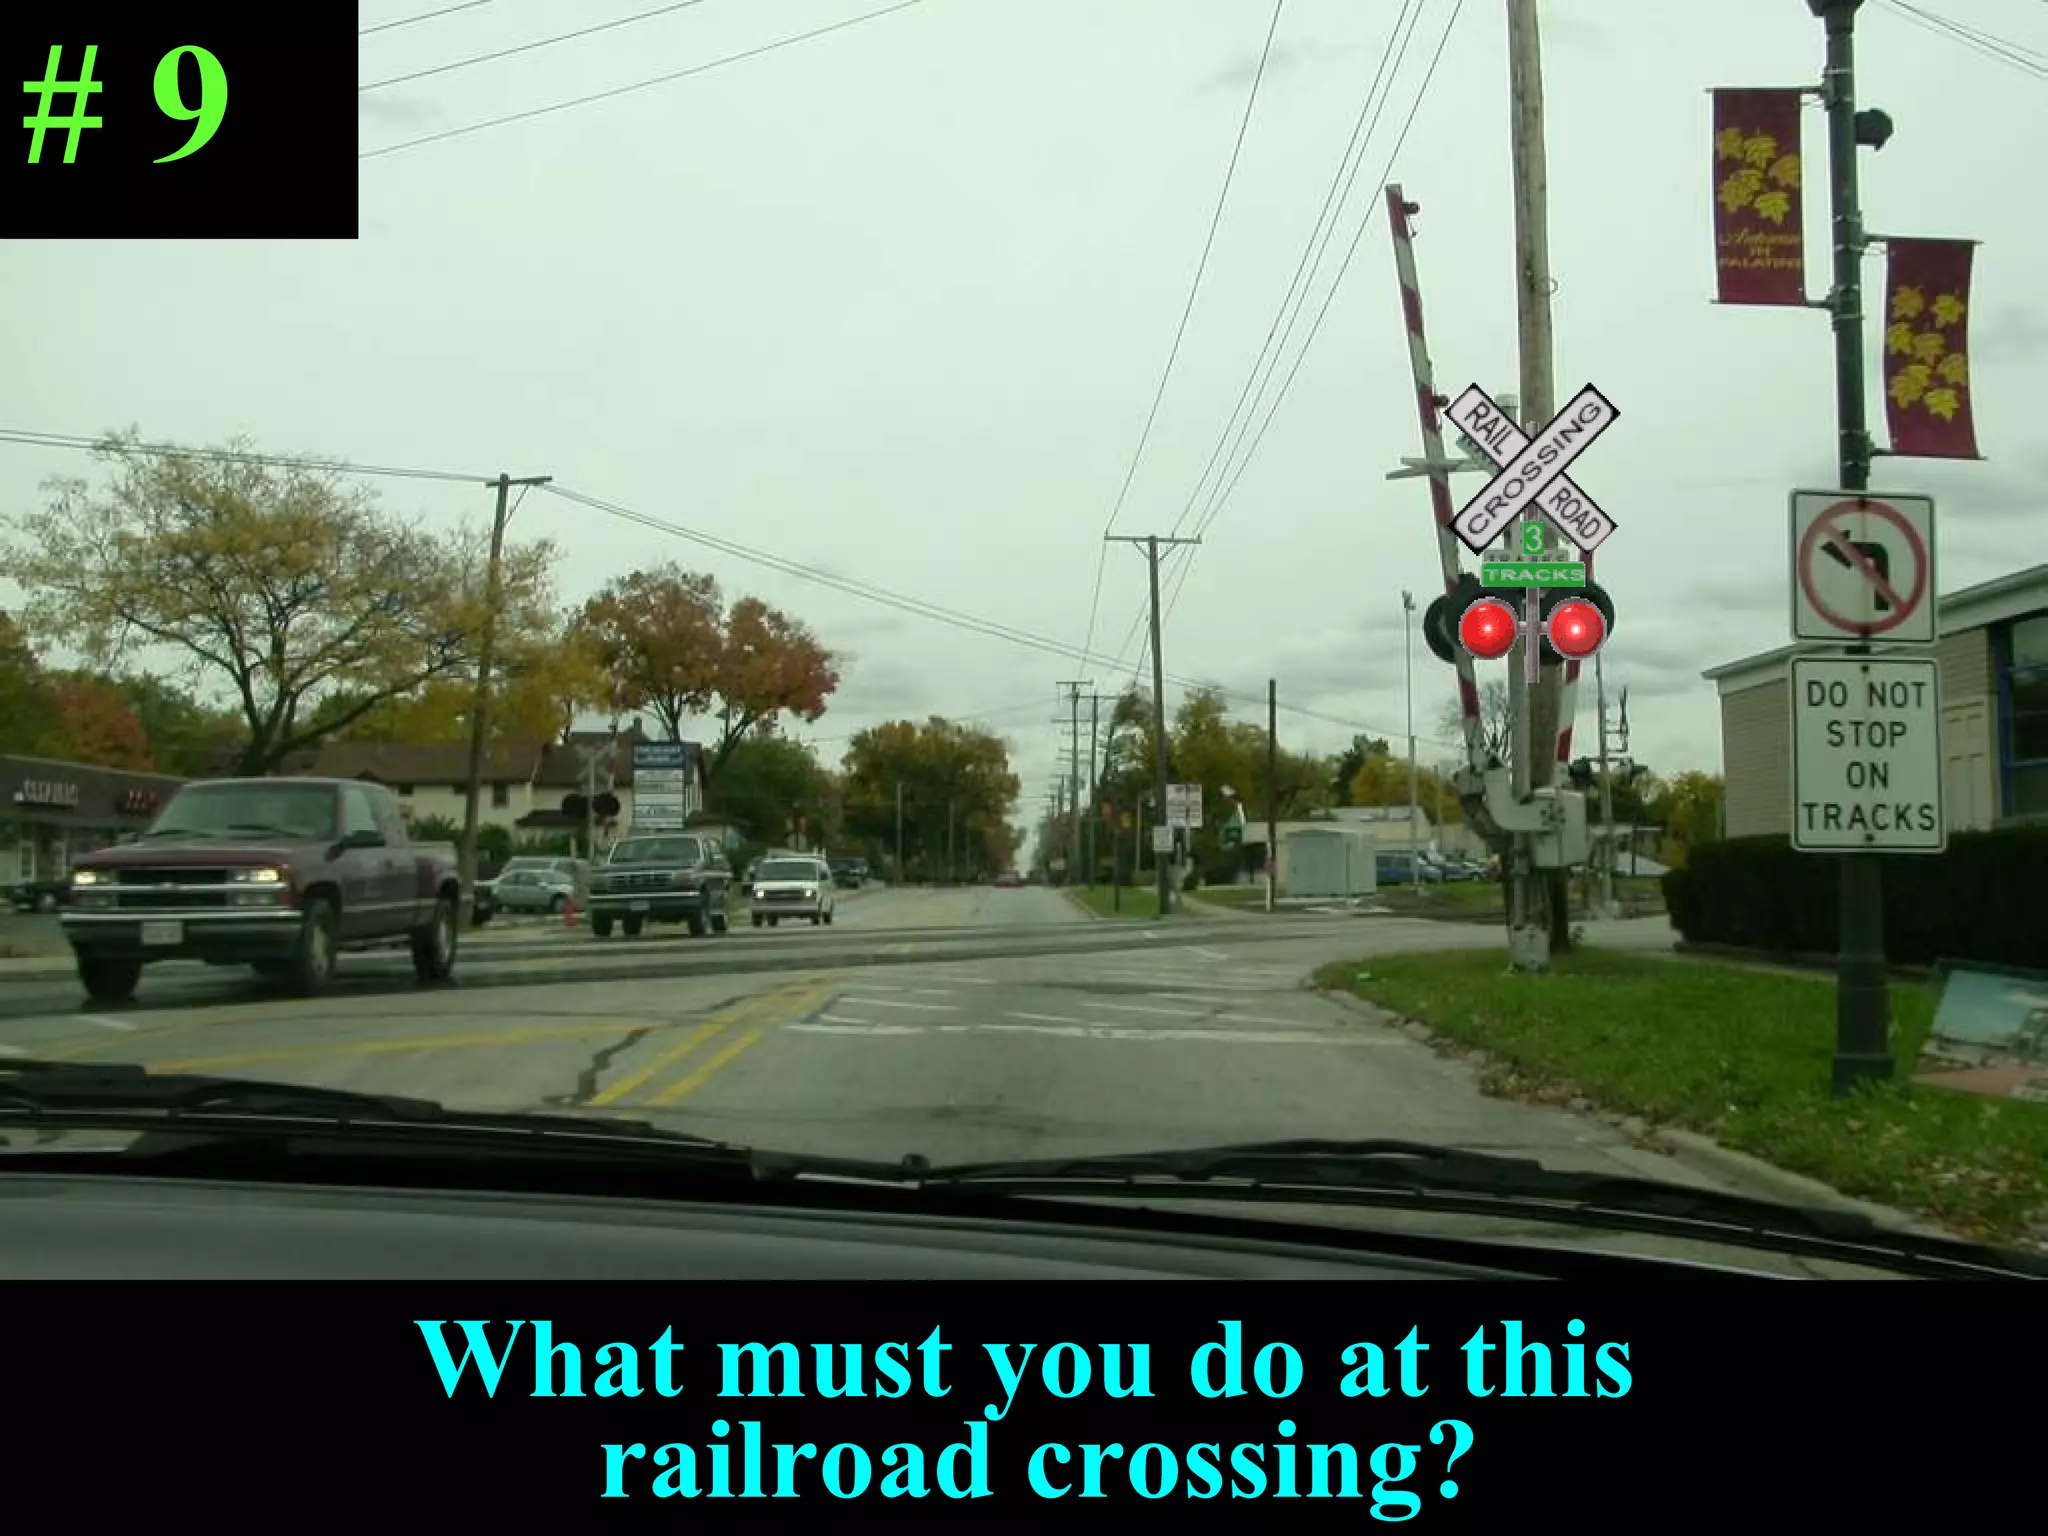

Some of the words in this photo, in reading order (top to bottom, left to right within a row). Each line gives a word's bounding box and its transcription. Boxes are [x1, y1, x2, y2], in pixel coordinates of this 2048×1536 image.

[1464, 400, 1513, 456] RAIL
[1549, 487, 1602, 539] ROAD
[1467, 402, 1602, 535] CROSSING
[1525, 524, 1543, 552] 3
[1483, 568, 1585, 582] TRACKS
[1807, 679, 1848, 707] DO
[1868, 681, 1927, 709] NOT
[1826, 719, 1907, 748] STOP
[1846, 760, 1889, 789] ON
[1801, 801, 1935, 831] TRACKS
